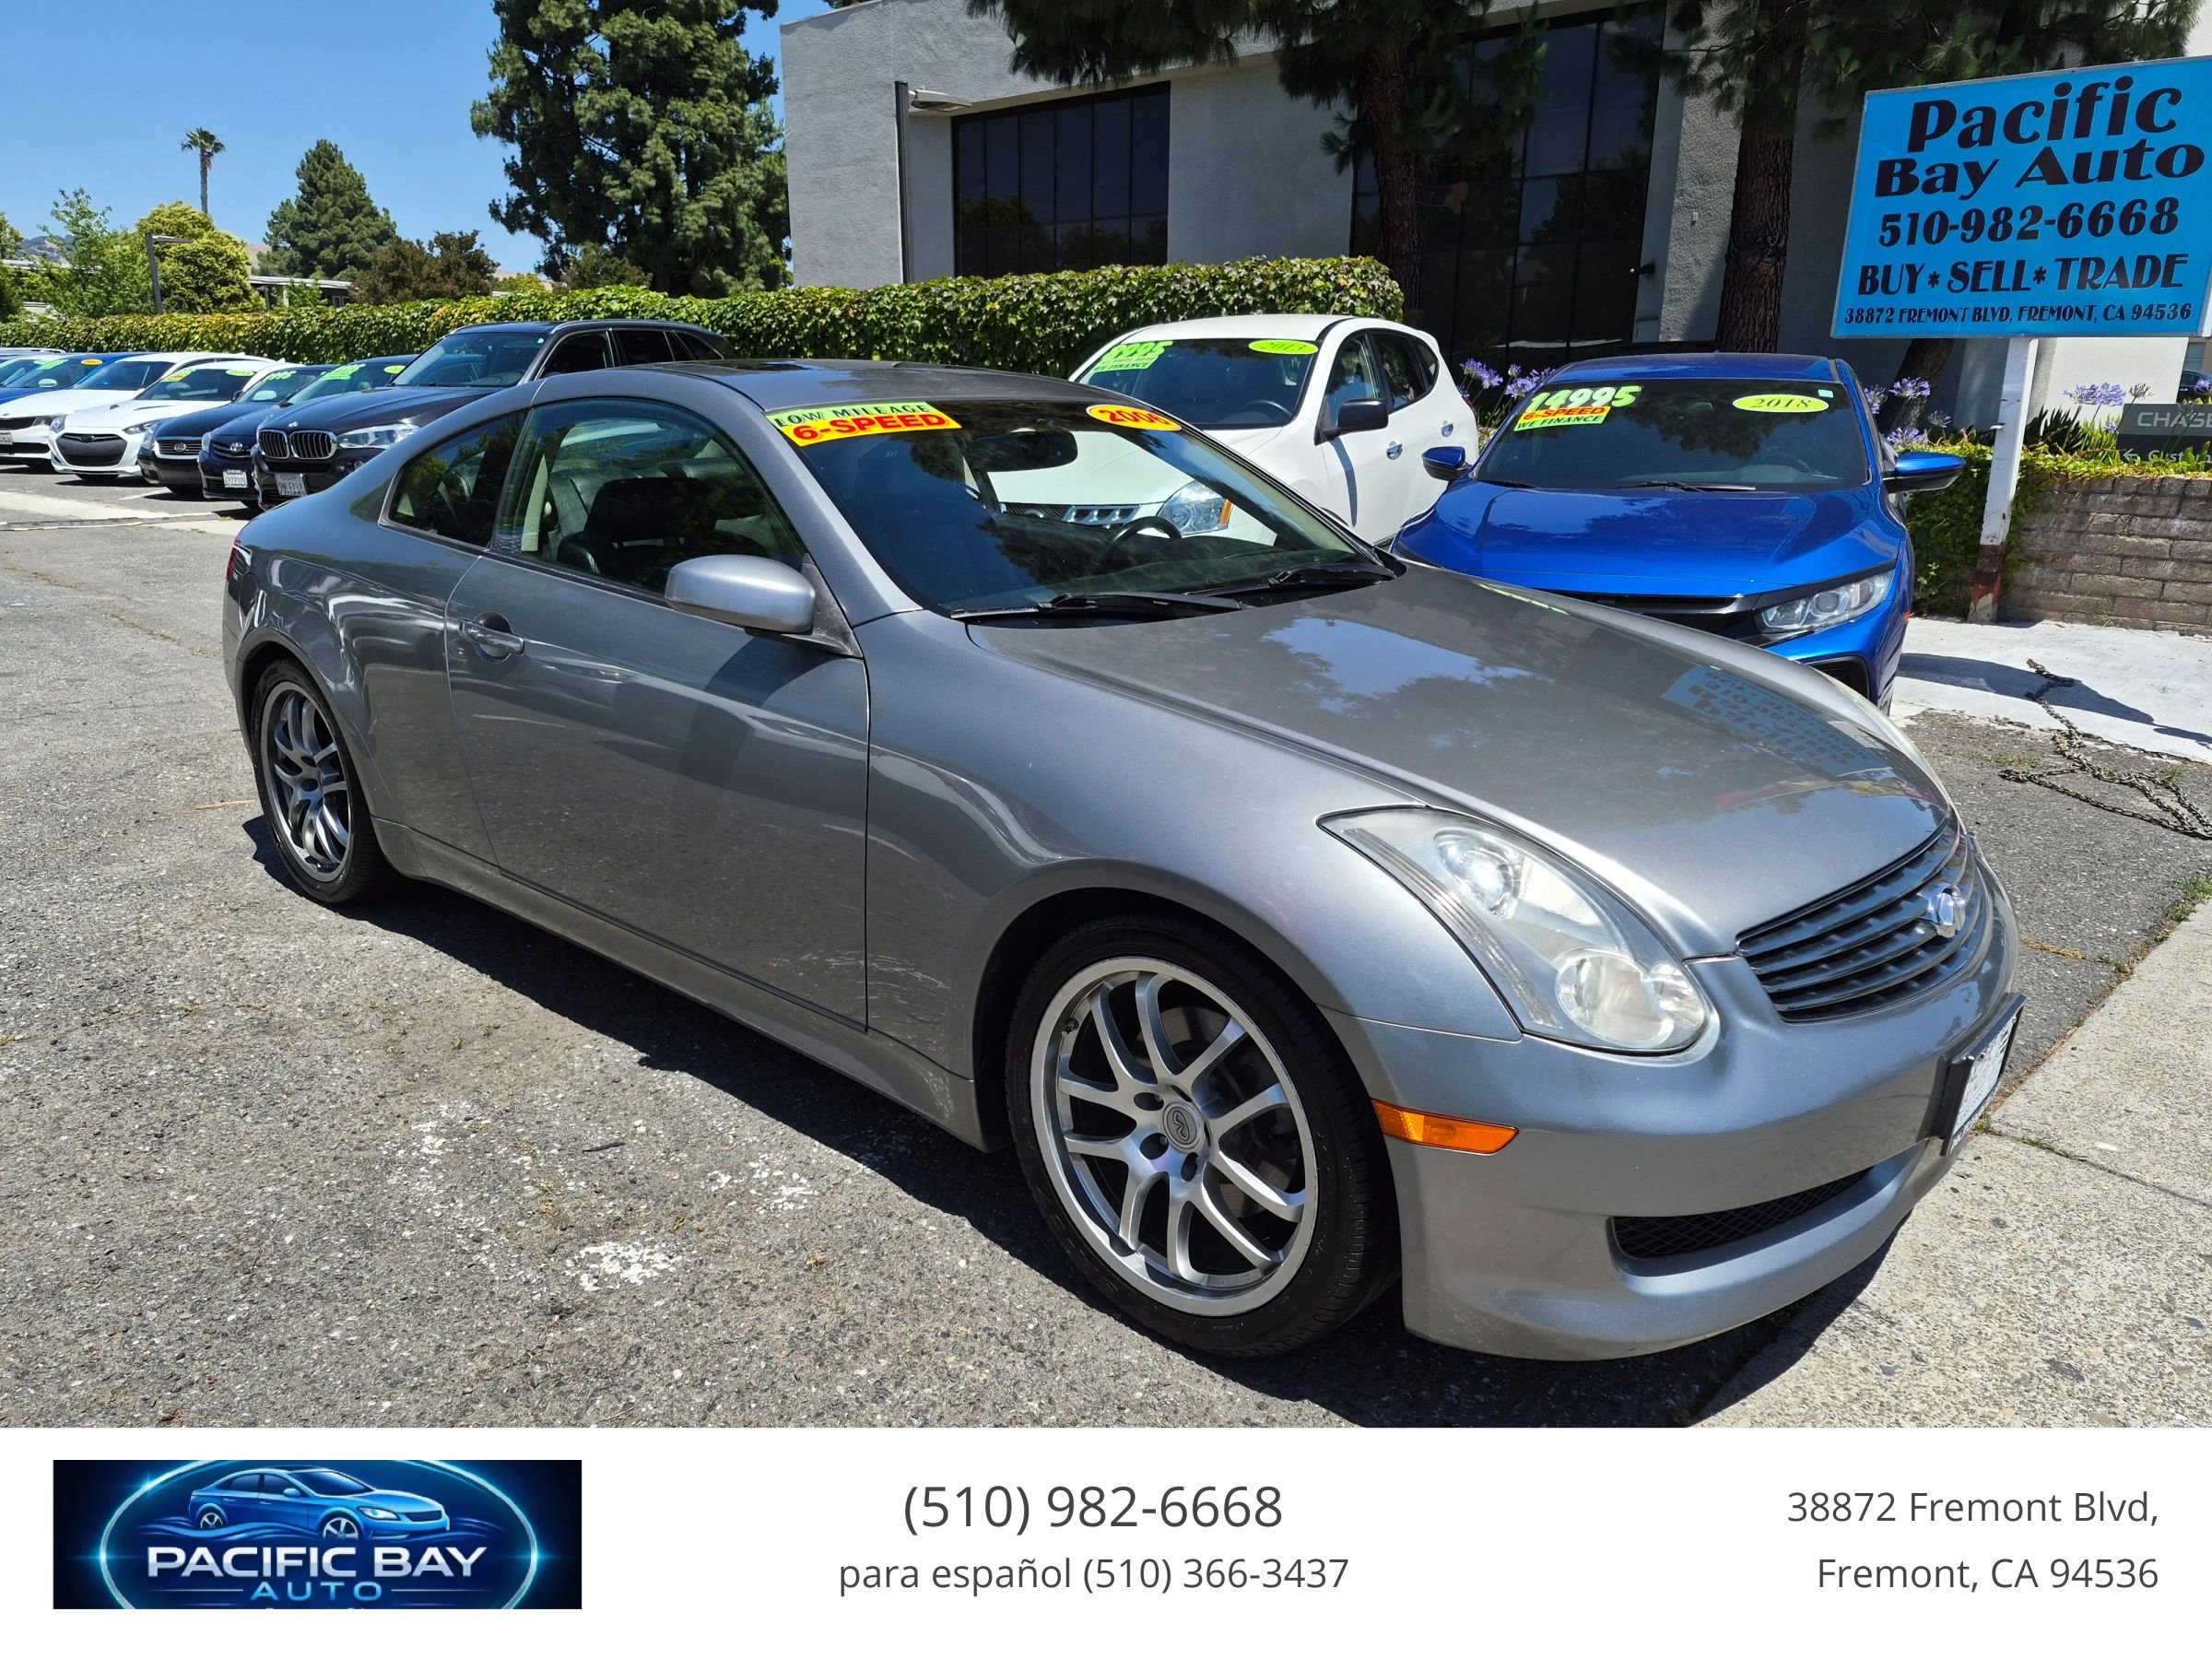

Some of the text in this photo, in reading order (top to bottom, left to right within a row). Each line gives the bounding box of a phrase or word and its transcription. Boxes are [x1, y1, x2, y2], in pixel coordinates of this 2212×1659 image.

[1907, 76, 2183, 153] Pacific
[1874, 137, 2205, 201] Bay Auto
[1878, 196, 2180, 247] 510-982-6668
[1857, 253, 2189, 296] BUY SELL TRADE
[1844, 302, 2192, 324] 38872 FREMONT BLVD, FREMONT, CA 94536
[1524, 406, 1606, 420] 6-SPEED
[1525, 386, 1641, 413] 14995
[1751, 398, 1813, 409] 2018
[773, 405, 931, 428] LOW MILEAGE
[793, 414, 947, 441] 6-SPEED
[1518, 415, 1603, 429] WE FINANCE
